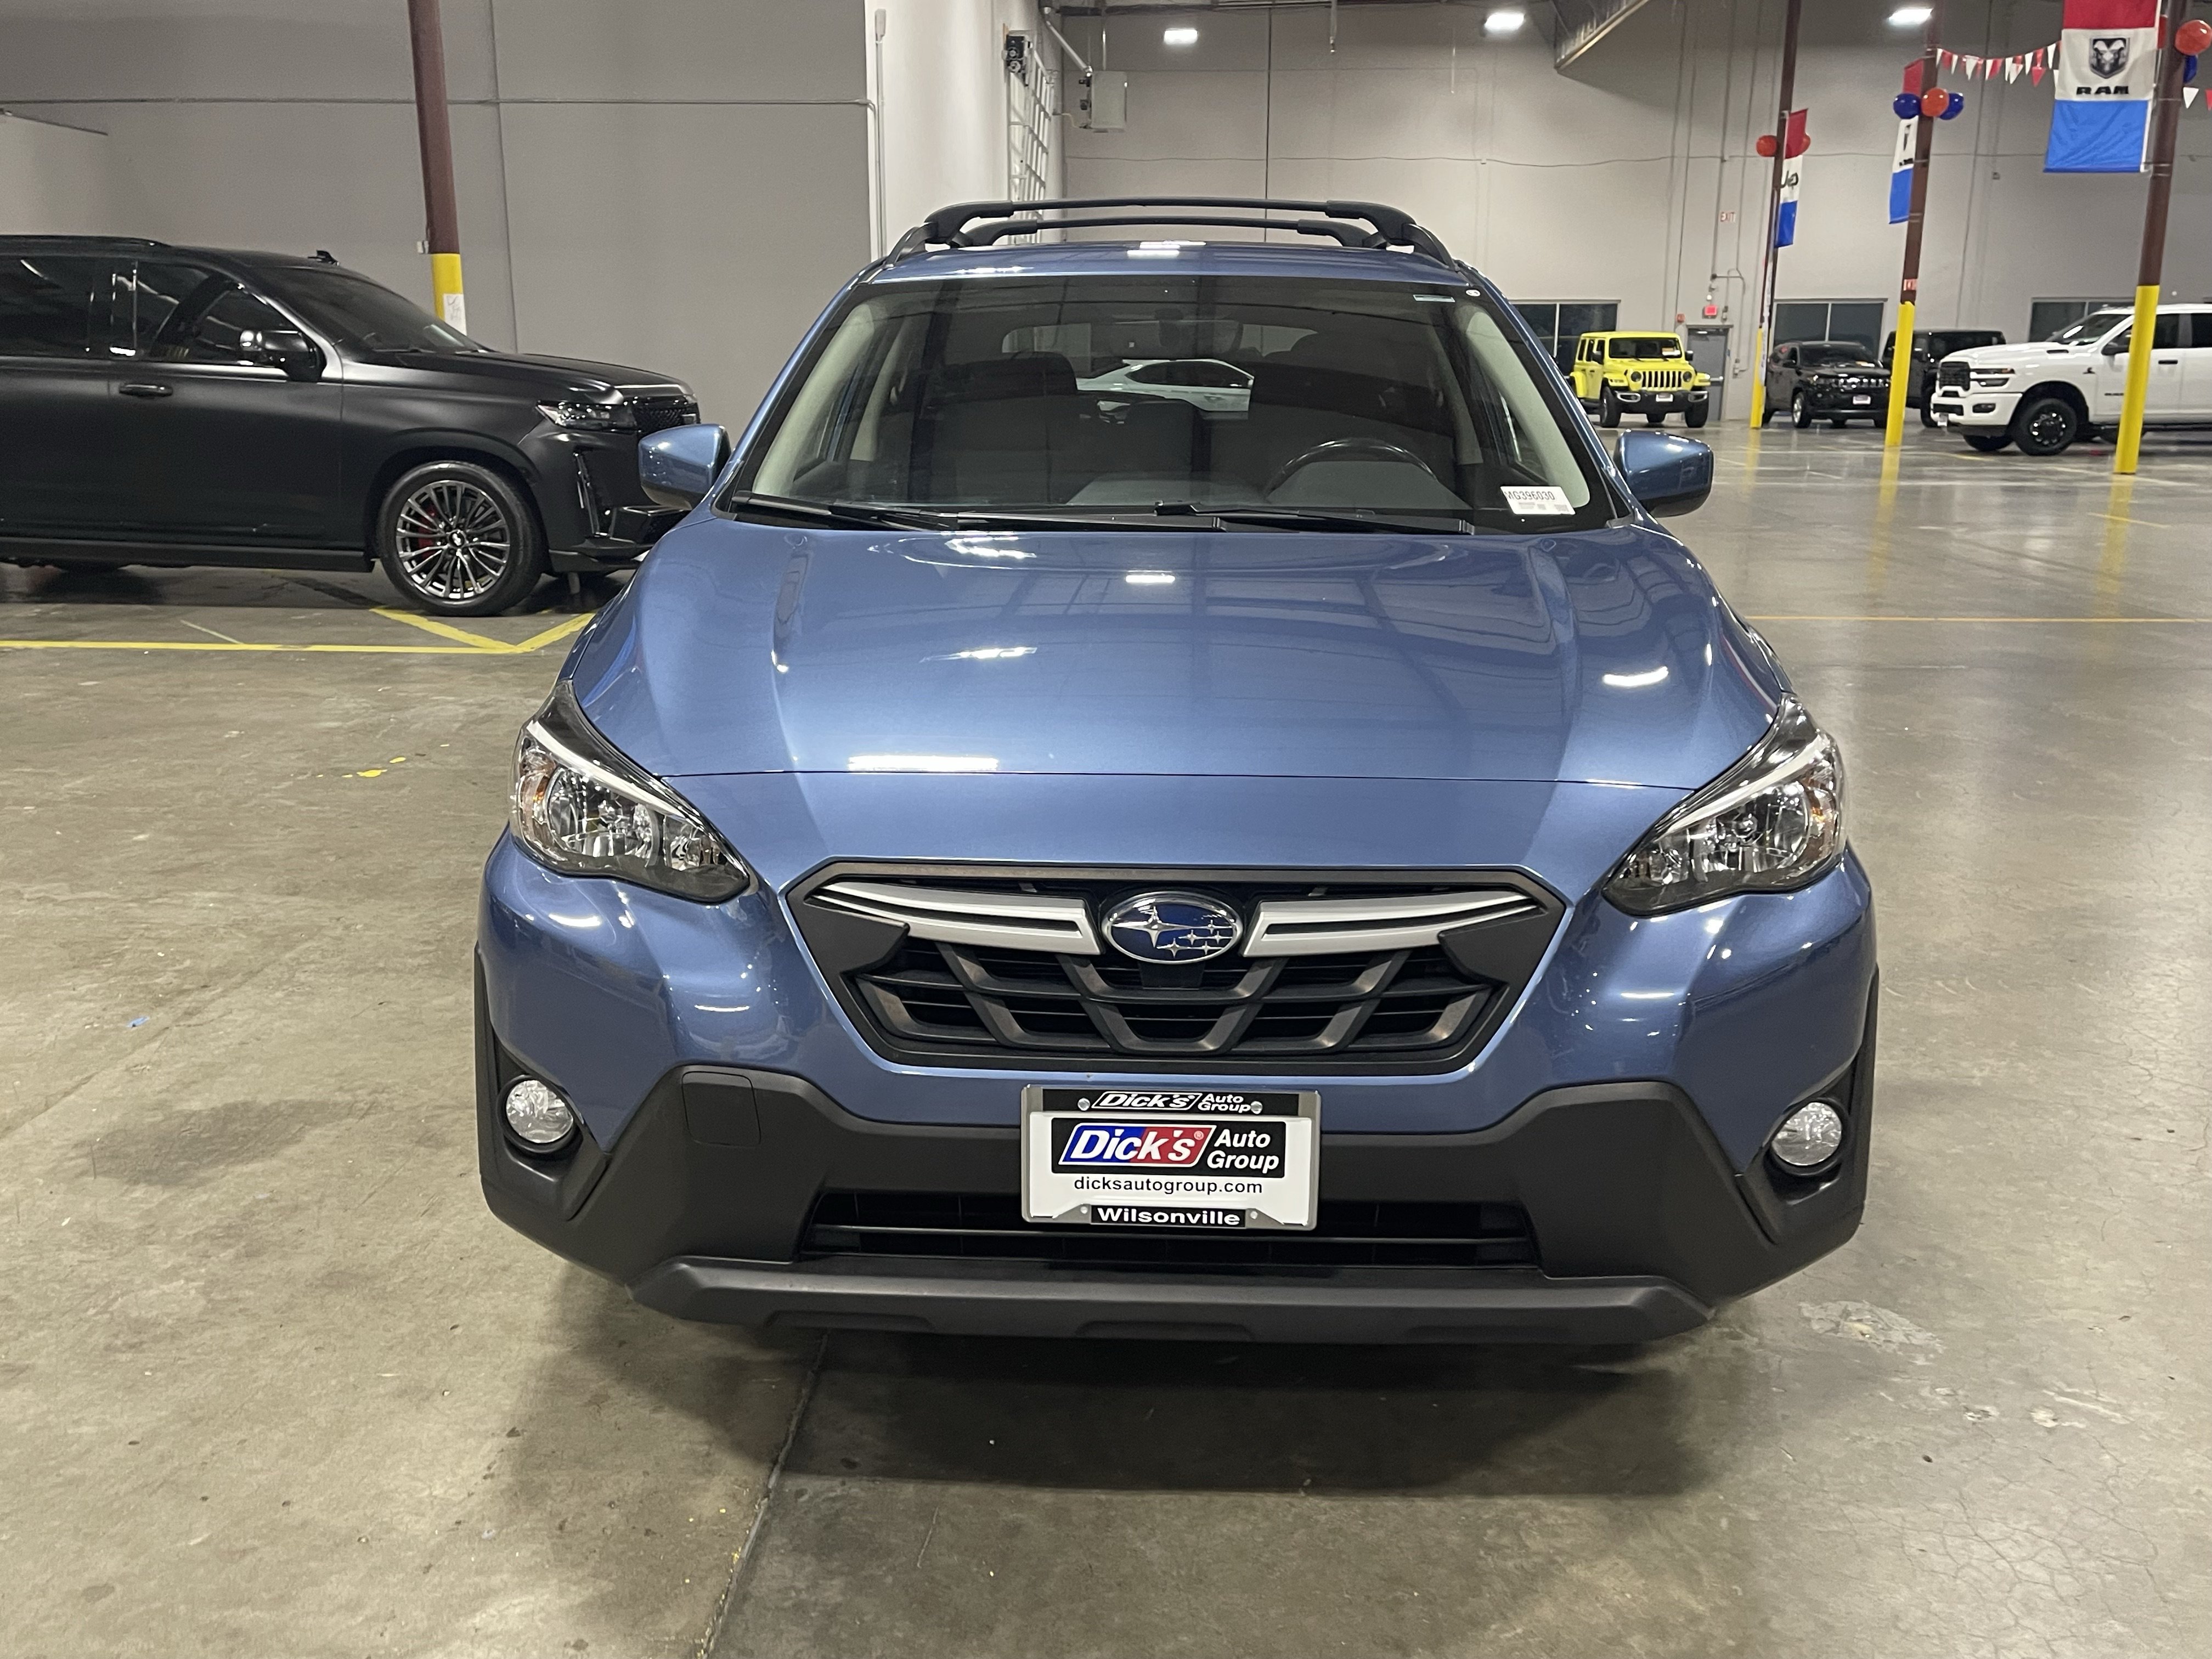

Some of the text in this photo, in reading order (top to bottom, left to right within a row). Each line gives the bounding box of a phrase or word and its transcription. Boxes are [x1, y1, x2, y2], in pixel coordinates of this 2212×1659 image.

[2076, 86, 2129, 95] RAM
[1099, 1093, 1190, 1108] Dick's
[1198, 1102, 1251, 1113] Group
[1201, 1093, 1244, 1103] Auto
[1070, 1128, 1196, 1161] Dick's
[1214, 1129, 1271, 1148] Auto
[1207, 1150, 1279, 1173] Group
[1074, 1176, 1262, 1195] dicksautogroup.com
[1097, 1207, 1240, 1226] Wilsonville
